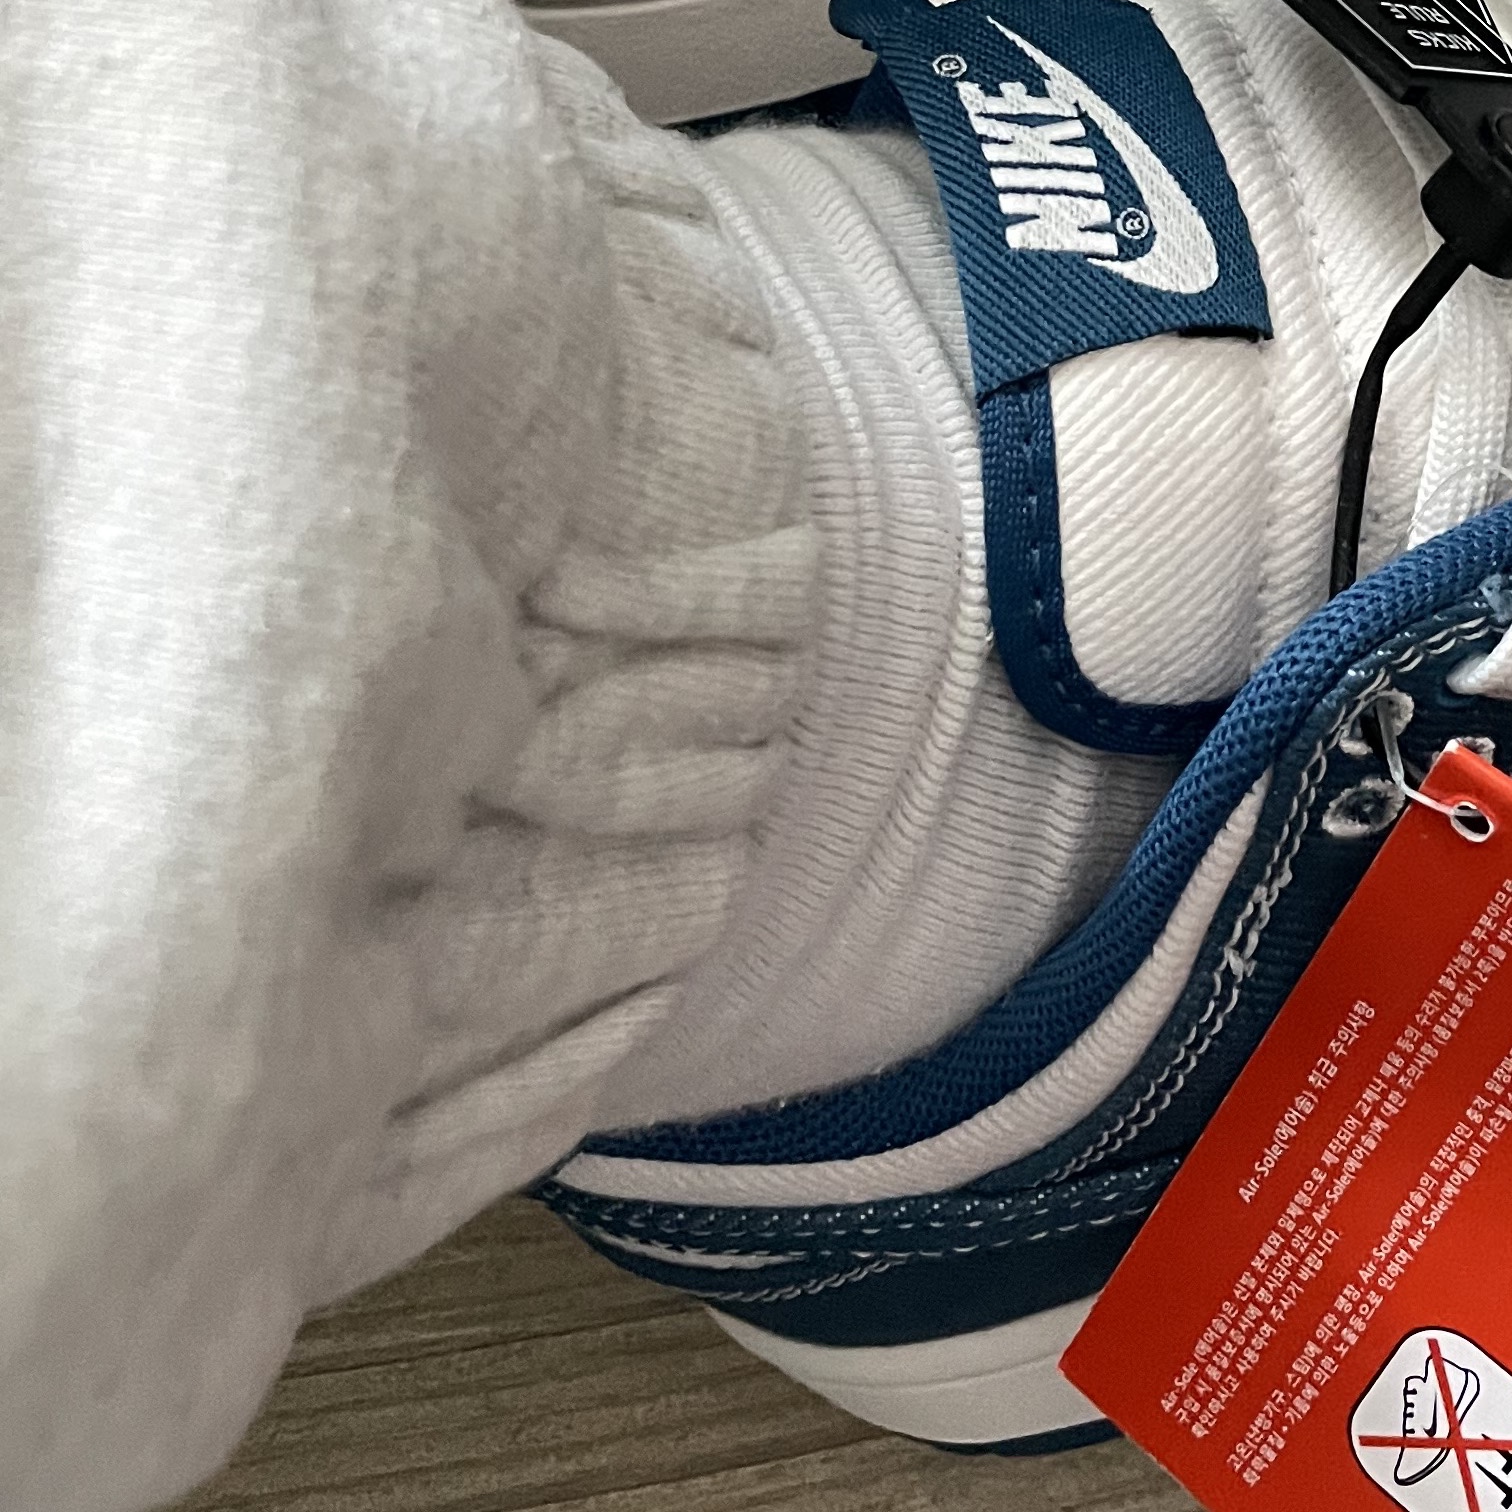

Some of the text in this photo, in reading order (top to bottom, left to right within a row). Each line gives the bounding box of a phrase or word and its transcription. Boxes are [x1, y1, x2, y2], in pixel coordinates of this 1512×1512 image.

[1379, 0, 1451, 25] RULE
[1407, 28, 1481, 53] KICKS
[956, 77, 1119, 257] NIKE
[1232, 1271, 1258, 1302] 신발
[1320, 1113, 1363, 1168] 제작되어
[1414, 988, 1447, 1027] 수리가
[1238, 999, 1376, 1204] Air-Sole(에어솔) 취급 주의사항
[1174, 1396, 1201, 1425] 구입
[1195, 1378, 1213, 1397] 시
[1291, 1225, 1318, 1254] 있는
[1380, 1089, 1407, 1118] 대한
[1397, 1041, 1439, 1091] 주의사항
[1312, 1355, 1340, 1387] 의한
[1377, 1247, 1415, 1291] 인하여
[1407, 1141, 1489, 1253] Air-Sole(에어솔)이
[1315, 1312, 1341, 1344] 의한
[1357, 1171, 1439, 1285] Air-Sole(에어솔)의
[1429, 1121, 1474, 1172] 직접적인
[1190, 1374, 1242, 1439] 확인하시고
[1235, 1321, 1277, 1375] 사용하여
[1269, 1280, 1305, 1322] 주시기
